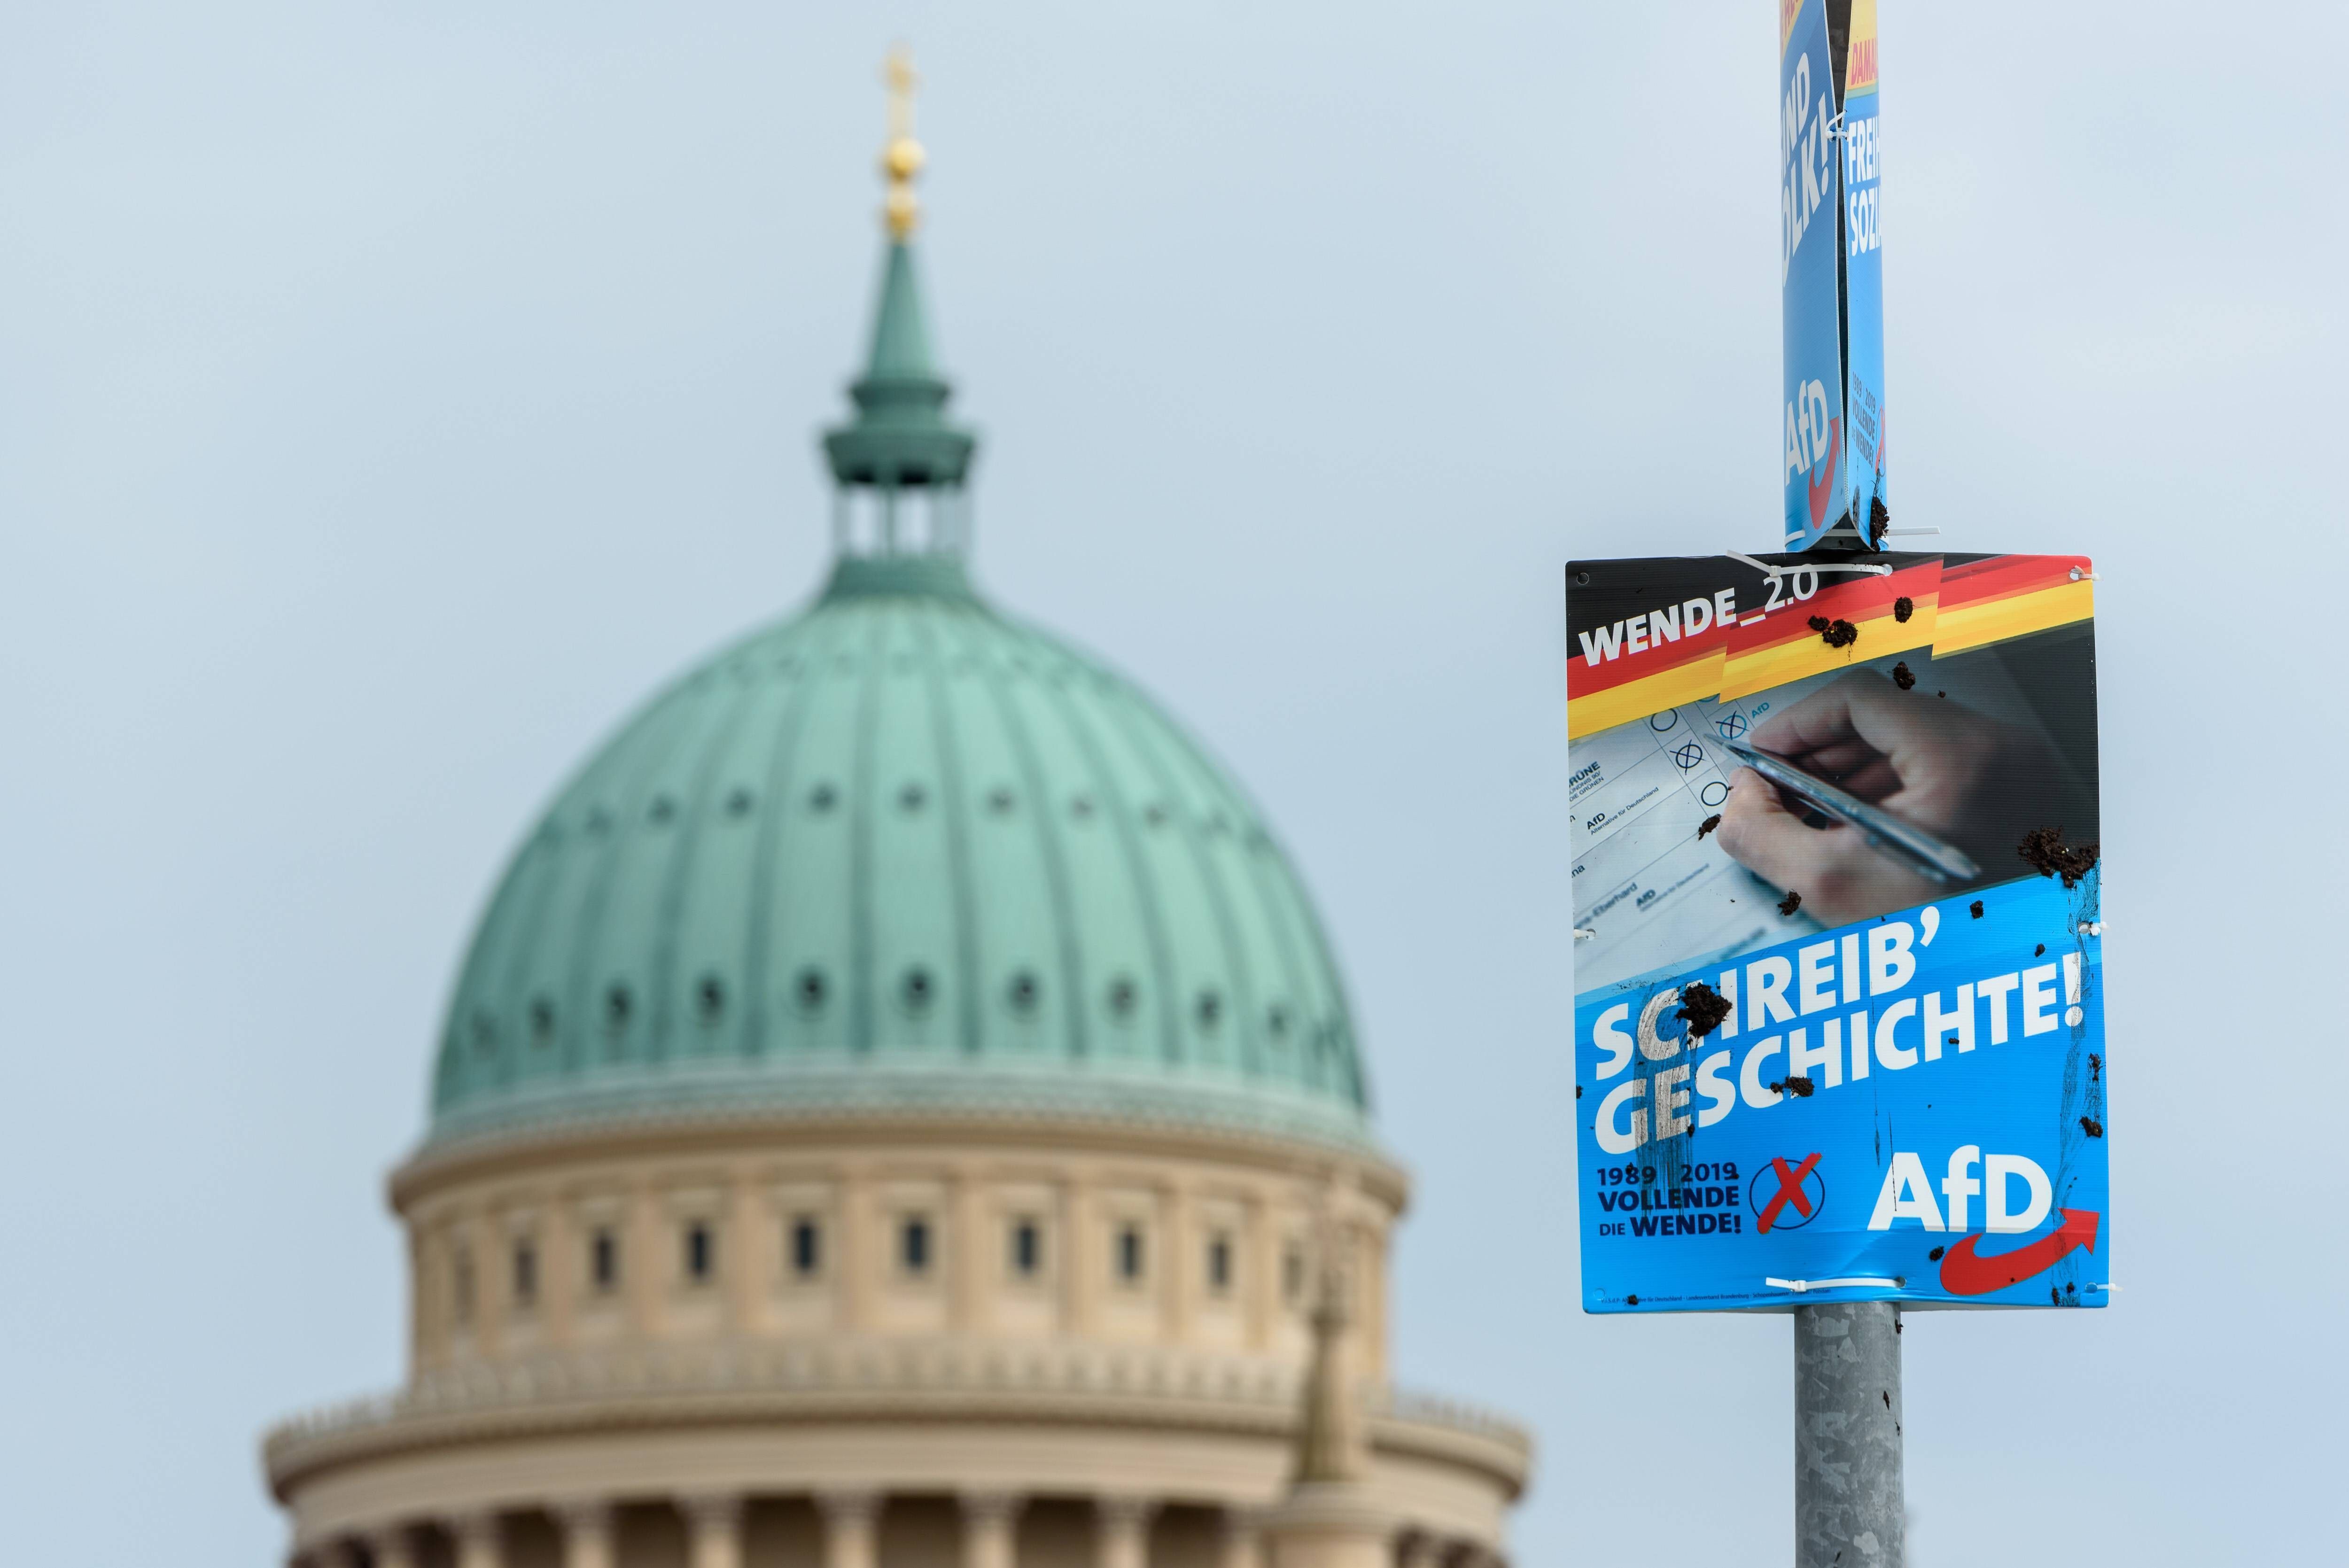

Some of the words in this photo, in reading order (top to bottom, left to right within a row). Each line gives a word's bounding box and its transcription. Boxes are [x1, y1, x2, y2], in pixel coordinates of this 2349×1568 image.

[1852, 371, 1862, 398] 1989
[1866, 388, 1876, 414] 2019
[1852, 394, 1875, 442] VOLLENDE
[1786, 379, 1828, 487] AfD
[1856, 426, 1874, 468] WENDE!
[1752, 702, 1769, 719] AfD
[1569, 761, 1601, 787] RÜNE
[1570, 777, 1592, 795] ÜNDNIS
[1569, 793, 1579, 802] DIE
[1579, 776, 1604, 795] GRÜNEN
[1587, 813, 1605, 830] AfD
[1591, 815, 1618, 835] Alternative
[1626, 787, 1659, 811] Deutschland
[1595, 951, 2083, 1155] GESCHICHTE!
[1597, 1165, 1657, 1186] 1989
[1680, 1162, 1738, 1183] 2019
[1598, 1186, 1740, 1212] VOLLENDE
[1867, 1145, 2053, 1234] AfD
[1599, 1223, 1626, 1236] DIE
[1629, 1212, 1742, 1237] WENDE!
